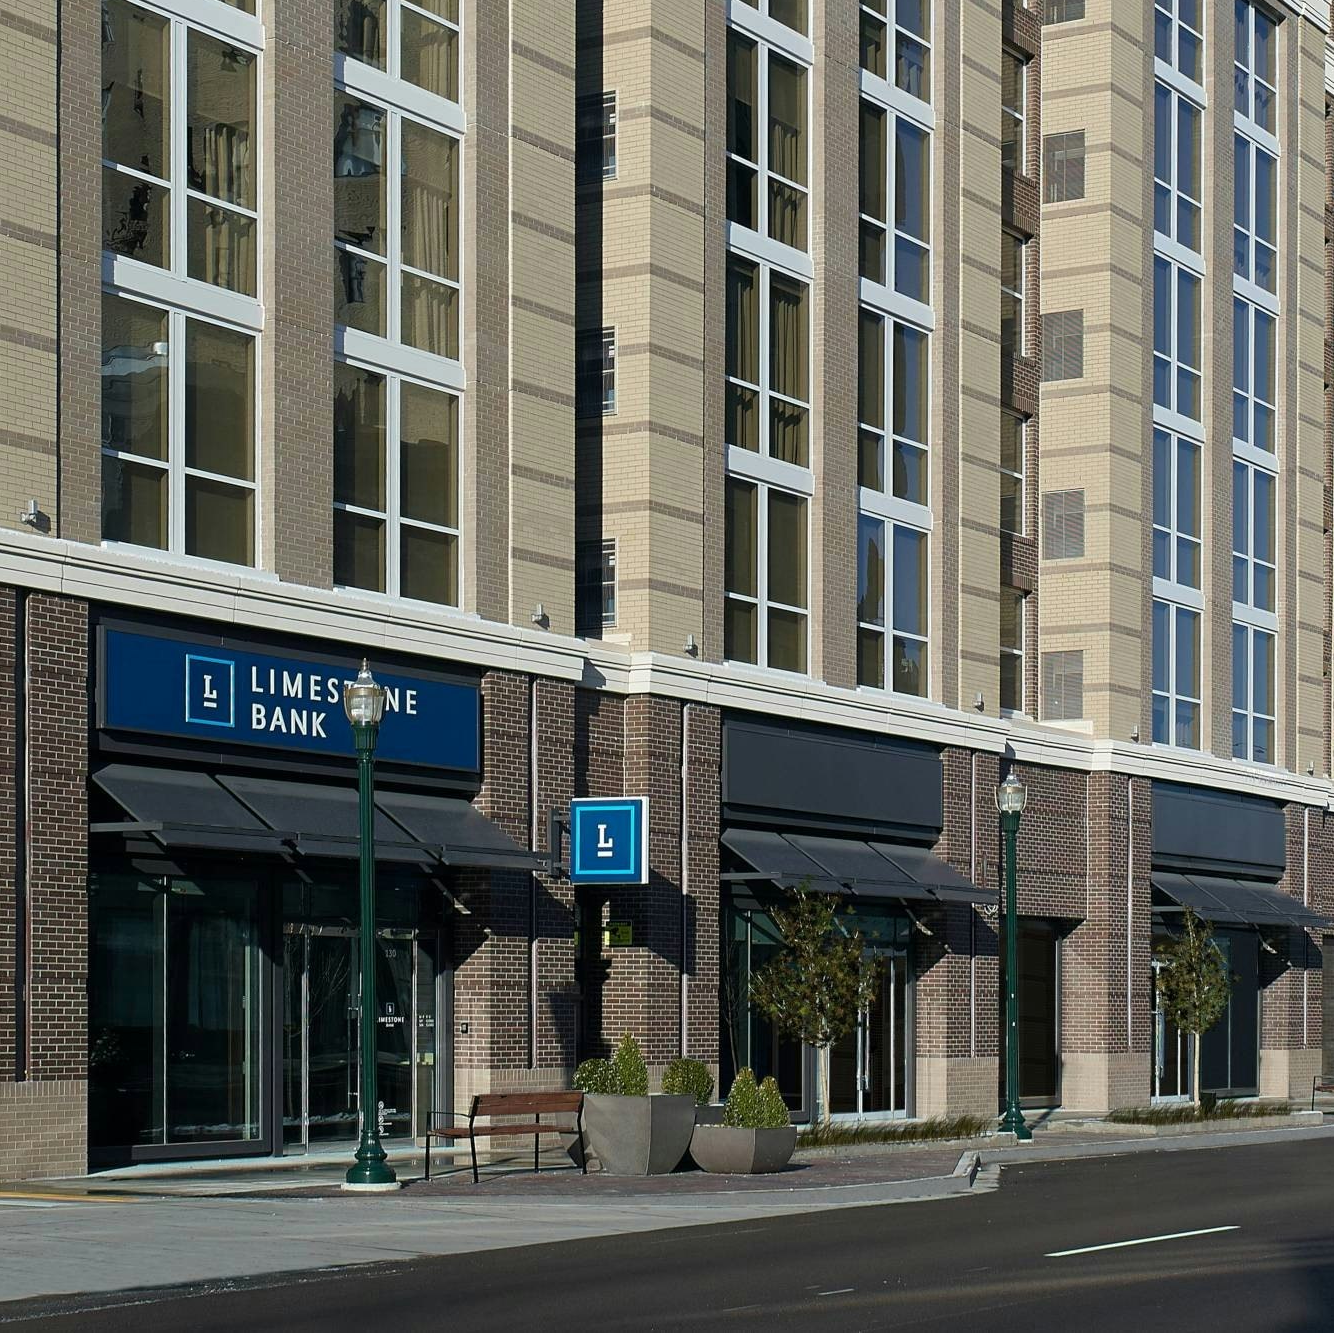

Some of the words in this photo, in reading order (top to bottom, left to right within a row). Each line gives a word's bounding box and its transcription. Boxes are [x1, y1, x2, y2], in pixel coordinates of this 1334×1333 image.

[251, 665, 417, 715] LIMESNE
[251, 703, 327, 739] BANK
[597, 824, 613, 848] L
